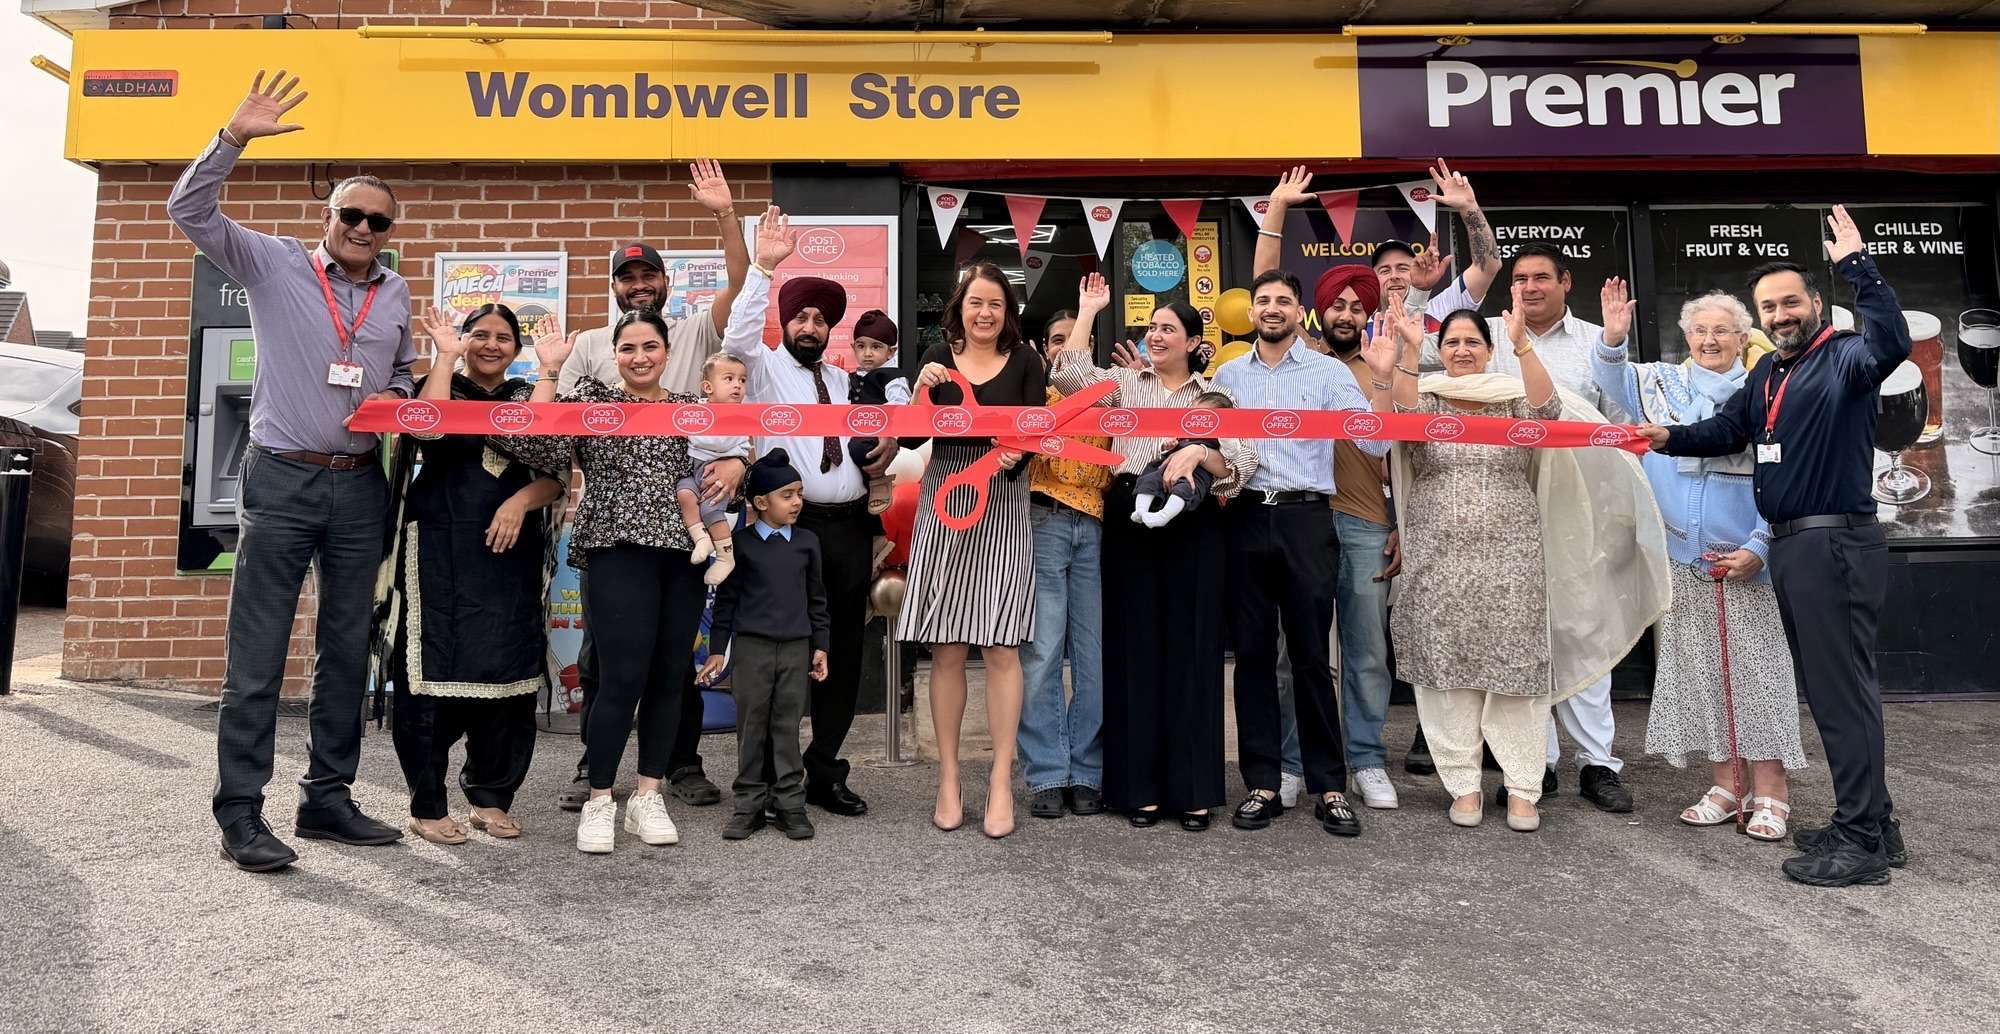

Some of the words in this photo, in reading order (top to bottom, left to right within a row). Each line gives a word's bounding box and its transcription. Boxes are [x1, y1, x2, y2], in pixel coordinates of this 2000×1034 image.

[104, 82, 170, 93] ALDHAM
[1426, 59, 1795, 127] Premier
[466, 72, 808, 118] Wombwell
[849, 72, 1020, 119] Store
[1496, 226, 1584, 239] EVERYDAY
[1710, 224, 1762, 238] FRESH
[1874, 222, 1942, 236] CHILLED
[809, 236, 834, 244] POST
[1301, 242, 1383, 256] WELCOM
[1498, 245, 1591, 258] SSALS
[1686, 244, 1733, 257] FRUIT
[1738, 244, 1750, 256] &
[1755, 243, 1789, 257] VEG
[1902, 242, 1915, 254] &
[1922, 241, 1964, 254] WINE
[443, 274, 506, 298] MEGA
[220, 282, 248, 306] fre
[452, 294, 496, 306] deals
[402, 414, 434, 422] OFFICE
[495, 416, 527, 424] OFFICE
